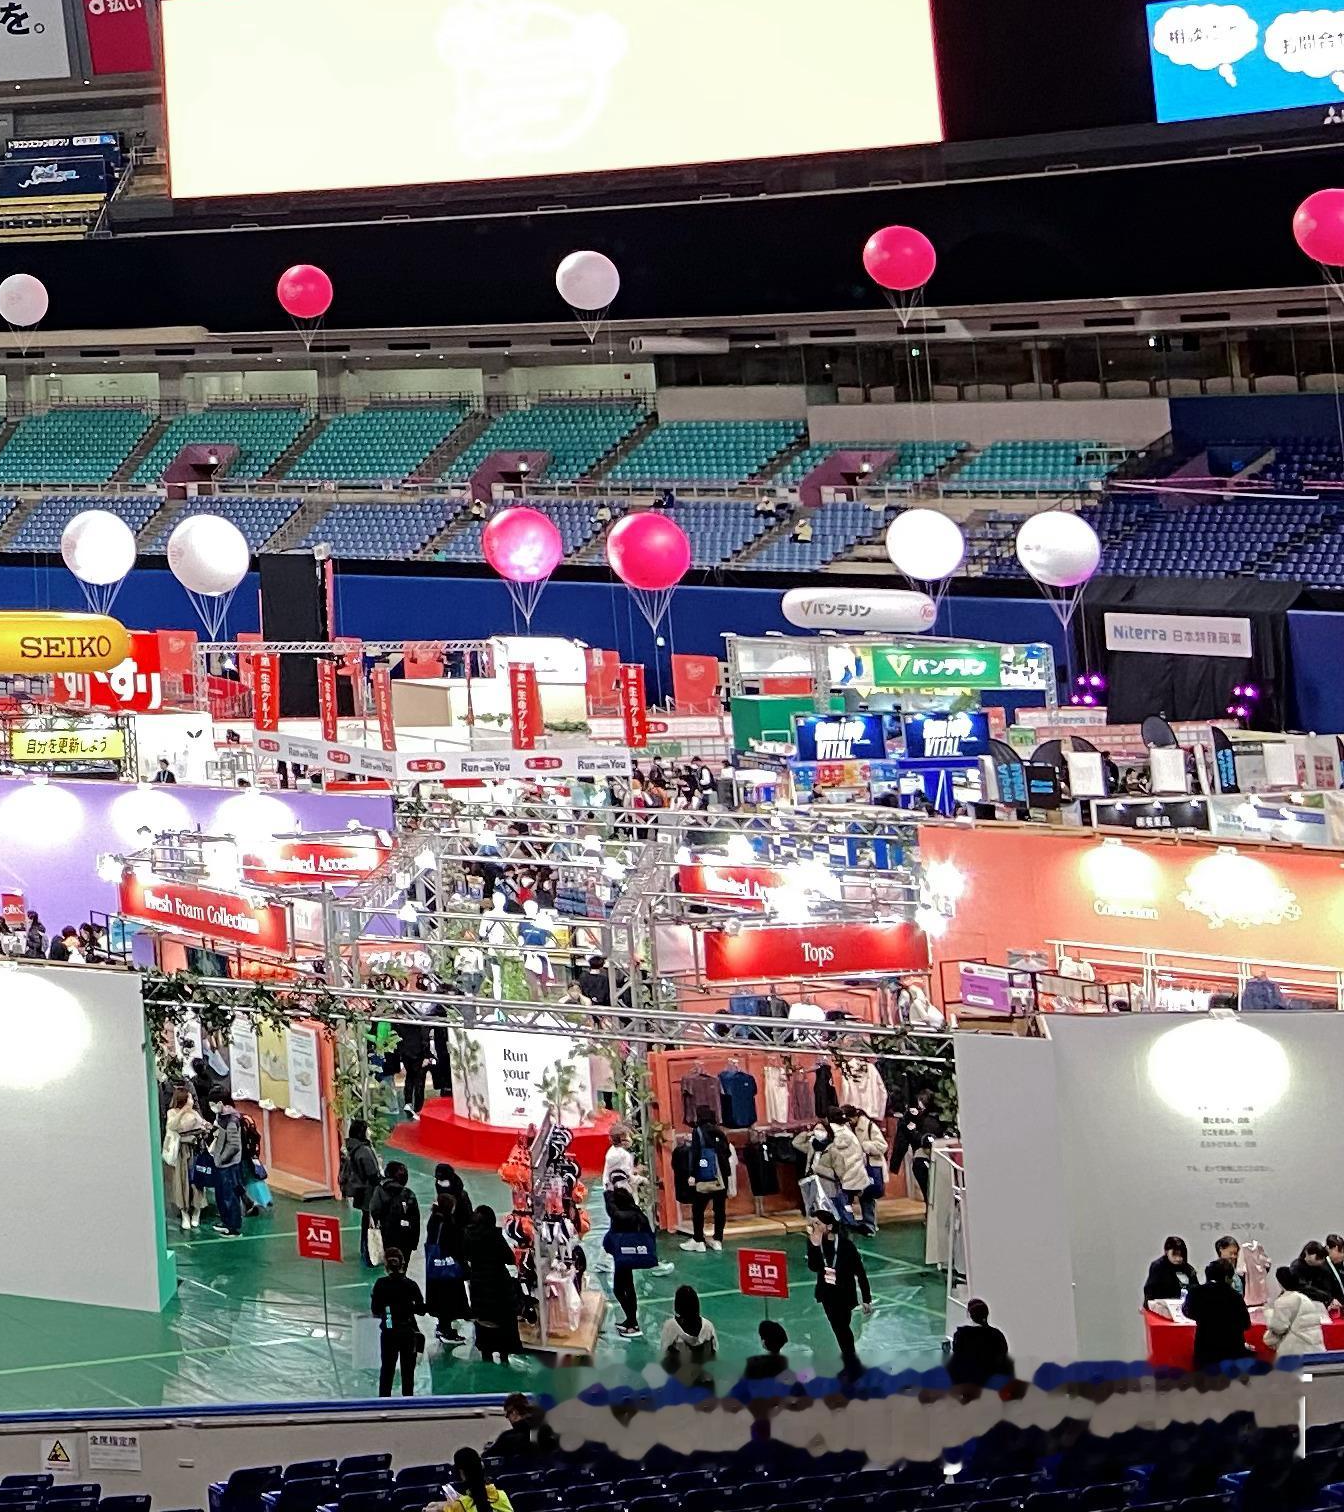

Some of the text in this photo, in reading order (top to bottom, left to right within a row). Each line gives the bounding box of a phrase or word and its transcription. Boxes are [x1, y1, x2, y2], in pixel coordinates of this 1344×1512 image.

[813, 602, 871, 617] バンテリン
[1113, 624, 1167, 641] Niterra
[20, 635, 111, 658] SEIKO
[911, 657, 986, 677] バンテリン
[27, 736, 107, 754] 自分を更新しよう
[288, 747, 299, 757] Run
[309, 749, 319, 760] You
[360, 759, 372, 769] Run
[381, 761, 393, 773] You
[460, 761, 479, 773] Run
[493, 761, 511, 772] You
[577, 759, 594, 769] Run
[608, 759, 627, 769] You
[175, 898, 204, 921] Foam
[801, 942, 835, 968] Tops
[503, 1048, 528, 1063] Run
[502, 1068, 530, 1082] your
[306, 1227, 332, 1243] 入口
[747, 1263, 778, 1279] 出口
